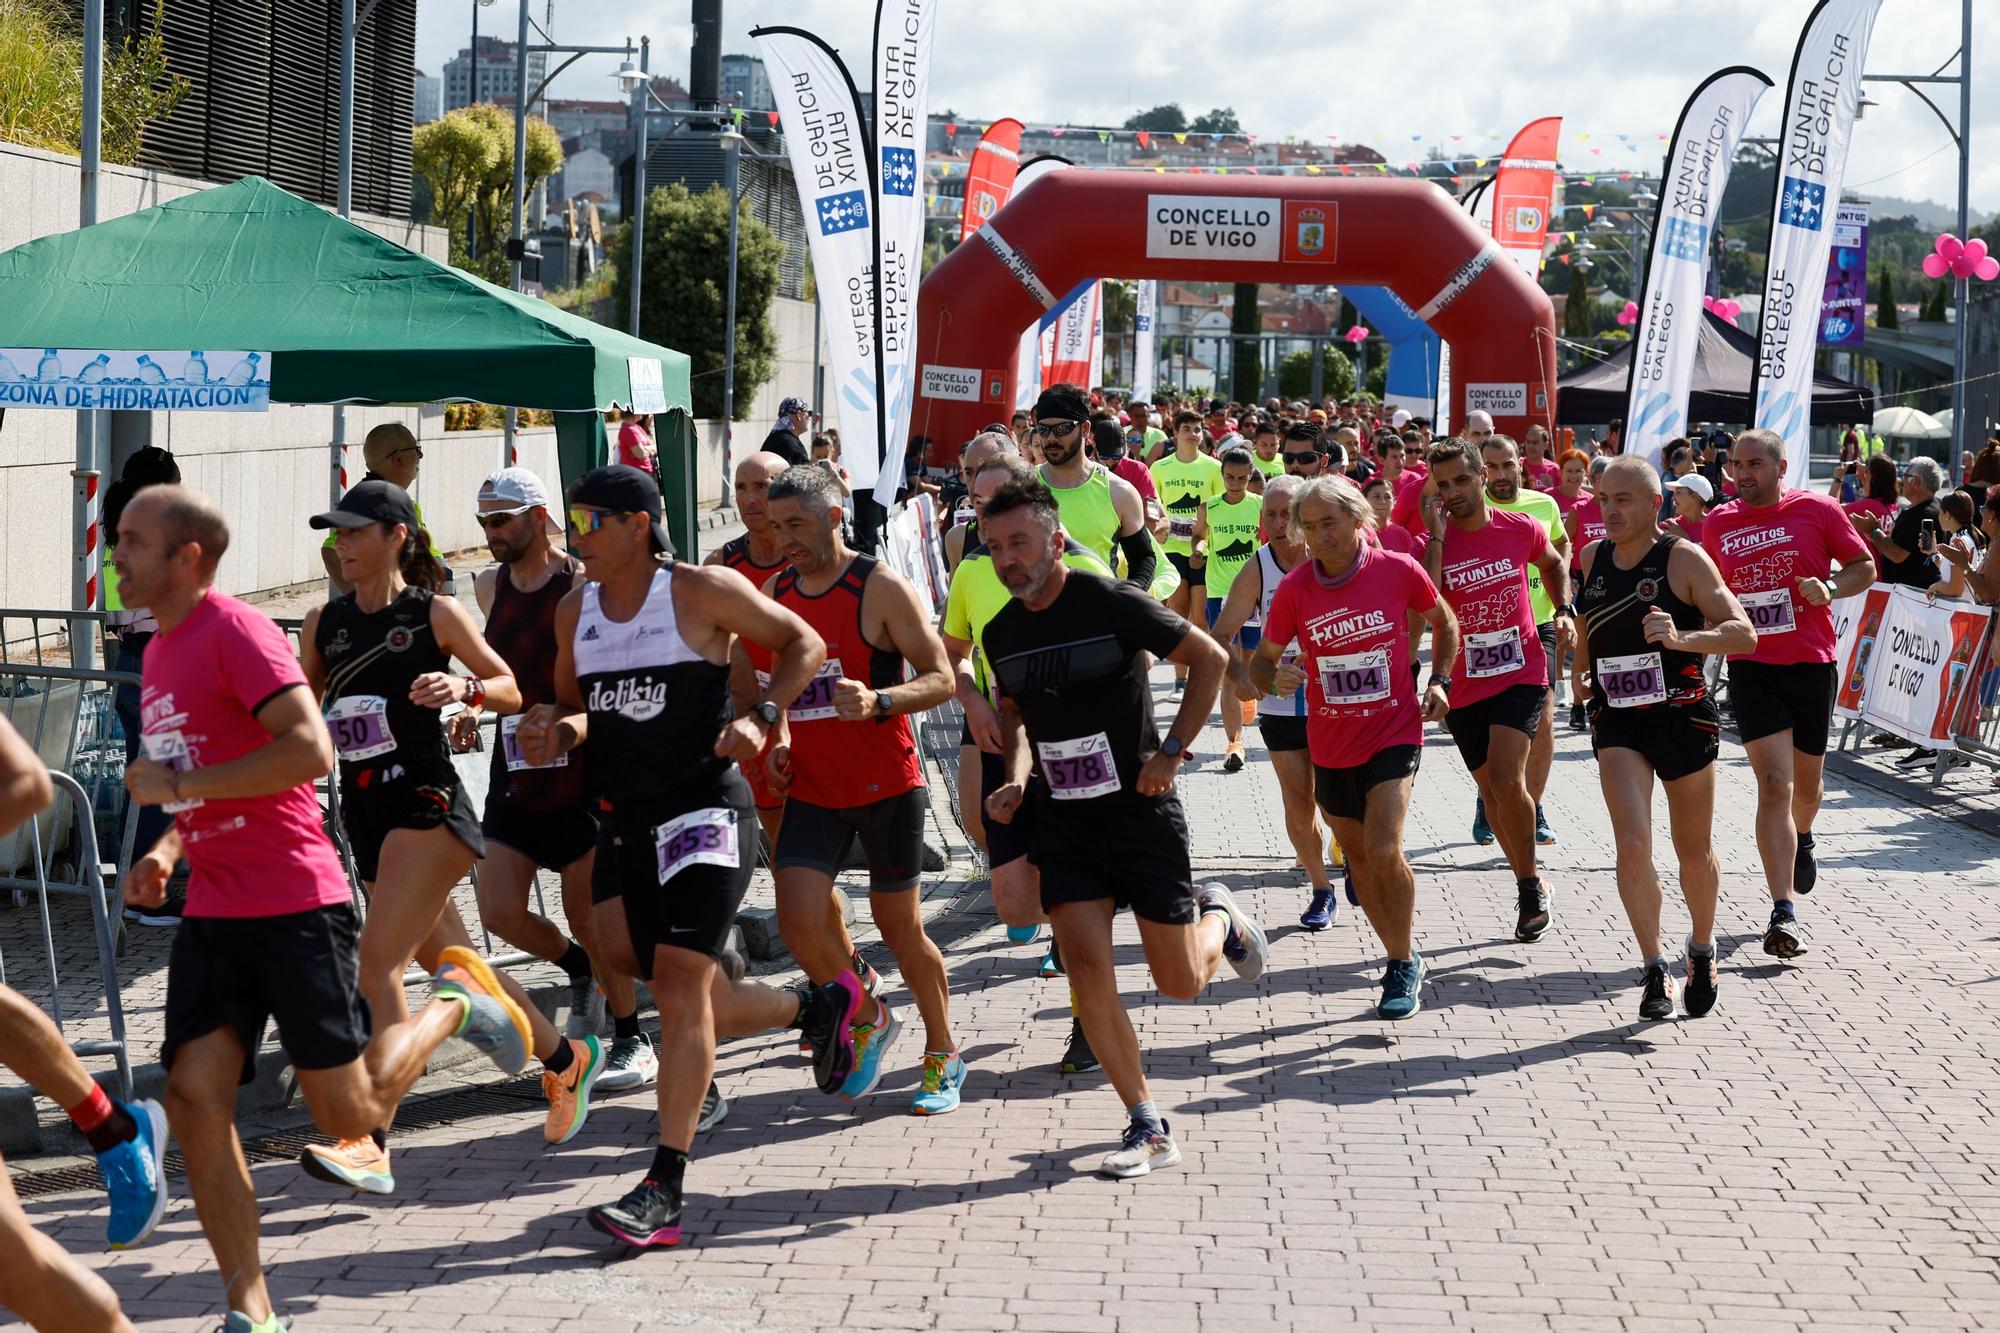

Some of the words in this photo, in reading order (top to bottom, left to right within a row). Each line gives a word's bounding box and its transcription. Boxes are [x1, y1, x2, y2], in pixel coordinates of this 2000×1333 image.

[885, 46, 900, 136] XUNTA
[1815, 33, 1850, 136] GALICIA
[901, 107, 914, 138] DE
[1789, 80, 1818, 169] XUNTA
[1697, 105, 1733, 186] GALICIA
[1808, 142, 1827, 175] DE
[1673, 139, 1702, 212] XUNTA
[1156, 208, 1270, 227] CONCELLO
[1689, 191, 1708, 218] DE
[1836, 212, 1866, 222] UNTOS
[1169, 230, 1197, 246] DE
[1205, 231, 1257, 247] VIGO
[985, 237, 1012, 268] terreo
[1011, 264, 1025, 280] de
[1025, 281, 1045, 303] xogo
[885, 241, 898, 352] DEPORTE
[1436, 284, 1466, 311] terreo
[1467, 270, 1481, 285] de
[1642, 290, 1663, 379] DEPORTE
[1759, 269, 1786, 379] DEPORTE
[1773, 282, 1795, 380] GALEGO
[1825, 317, 1847, 336] life
[1652, 302, 1674, 381] GALEGO
[925, 371, 976, 384] CONCELLO
[929, 382, 941, 392] DE
[944, 384, 969, 394] VIGO
[0, 384, 58, 407] ZONA
[65, 387, 93, 409] DE
[1469, 389, 1522, 399] CONCELLO
[1474, 400, 1488, 409] DE
[1492, 400, 1516, 409] VIGO
[1187, 479, 1204, 488] auga
[1236, 524, 1256, 535] auga
[1025, 648, 1072, 689] RUN
[1472, 643, 1513, 667] 250
[588, 676, 667, 712] delikia
[795, 676, 833, 706] 91
[1331, 668, 1379, 693] 104
[1607, 668, 1653, 695] 460
[1899, 667, 1925, 698] VIGO
[336, 717, 369, 748] 50
[1050, 755, 1102, 785] 578
[668, 823, 722, 860] 653
